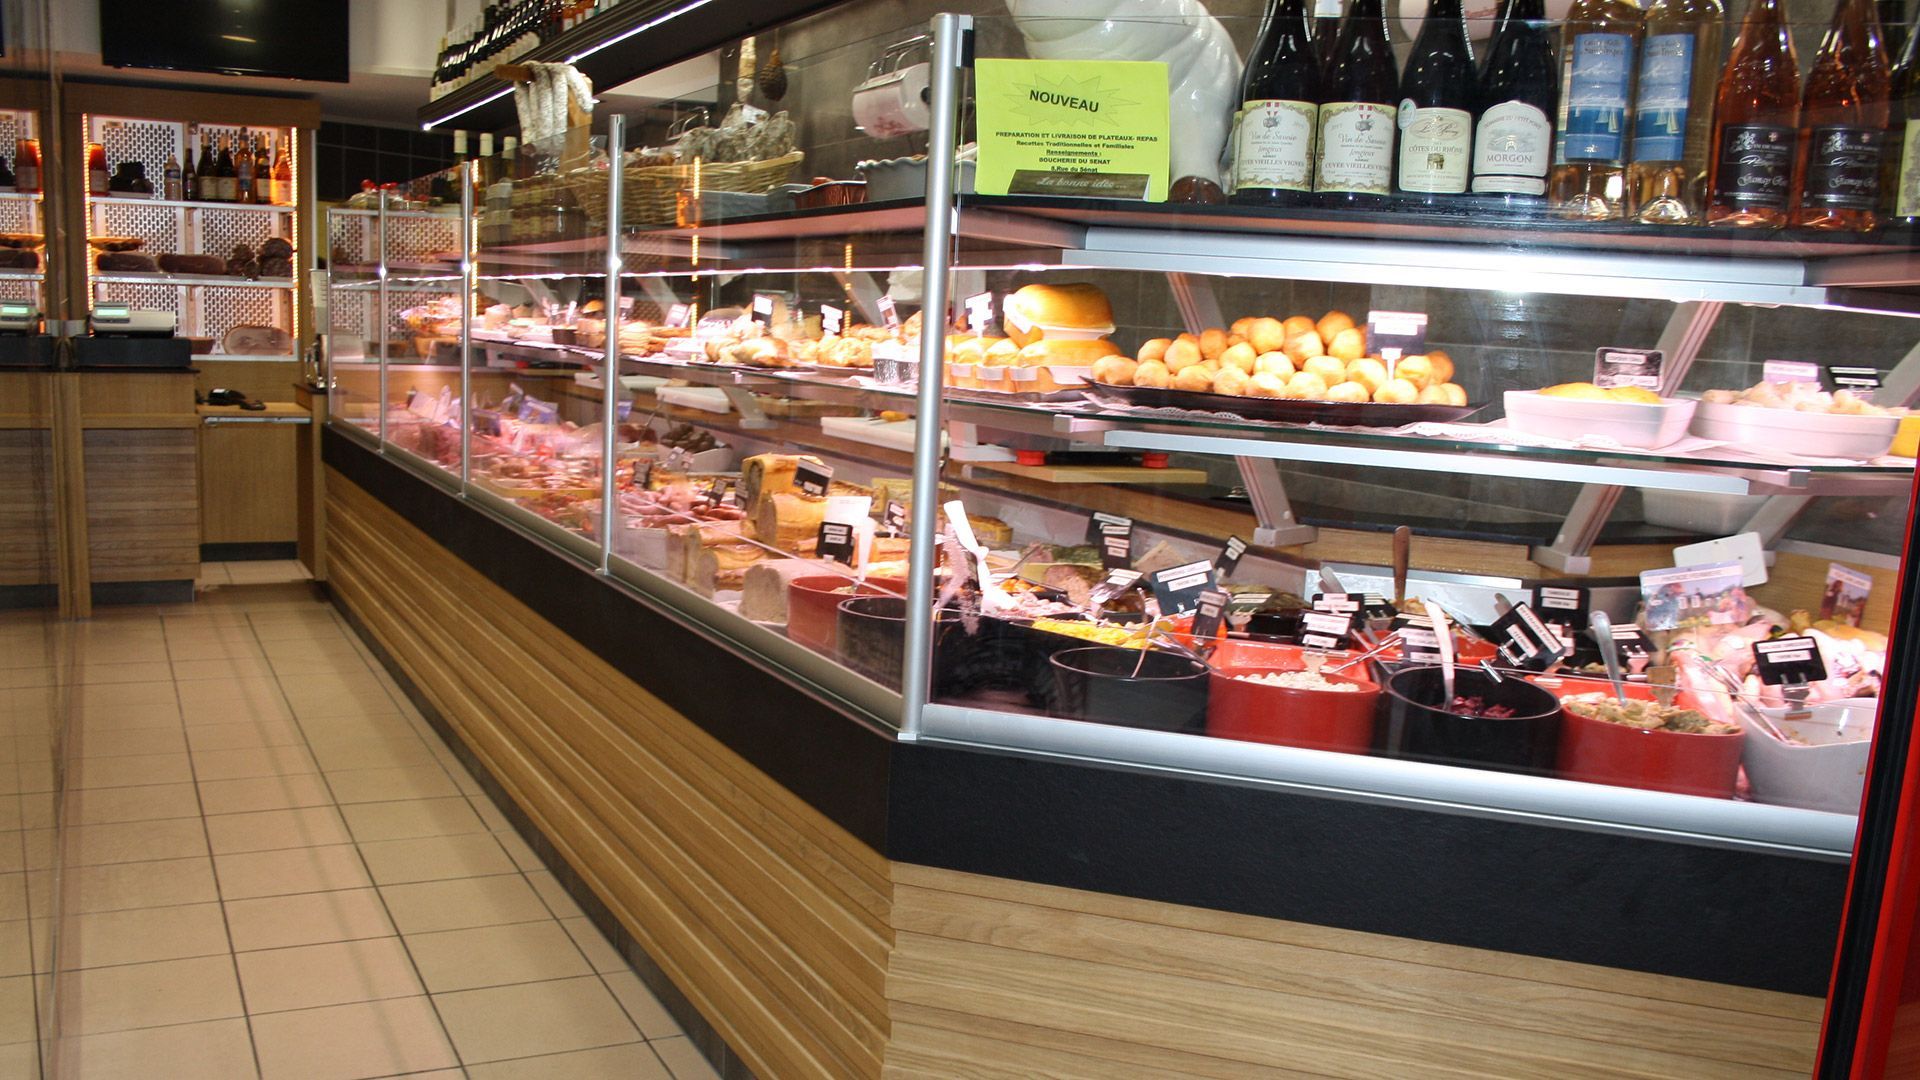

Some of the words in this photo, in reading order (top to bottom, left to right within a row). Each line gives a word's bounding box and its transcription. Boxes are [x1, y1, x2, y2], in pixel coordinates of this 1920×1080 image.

[1029, 89, 1099, 113] NOUVEAU
[1046, 141, 1092, 149] Traditionnelles
[1486, 153, 1532, 163] MORGON
[1036, 177, 1053, 186] La
[1056, 178, 1089, 187] bonne
